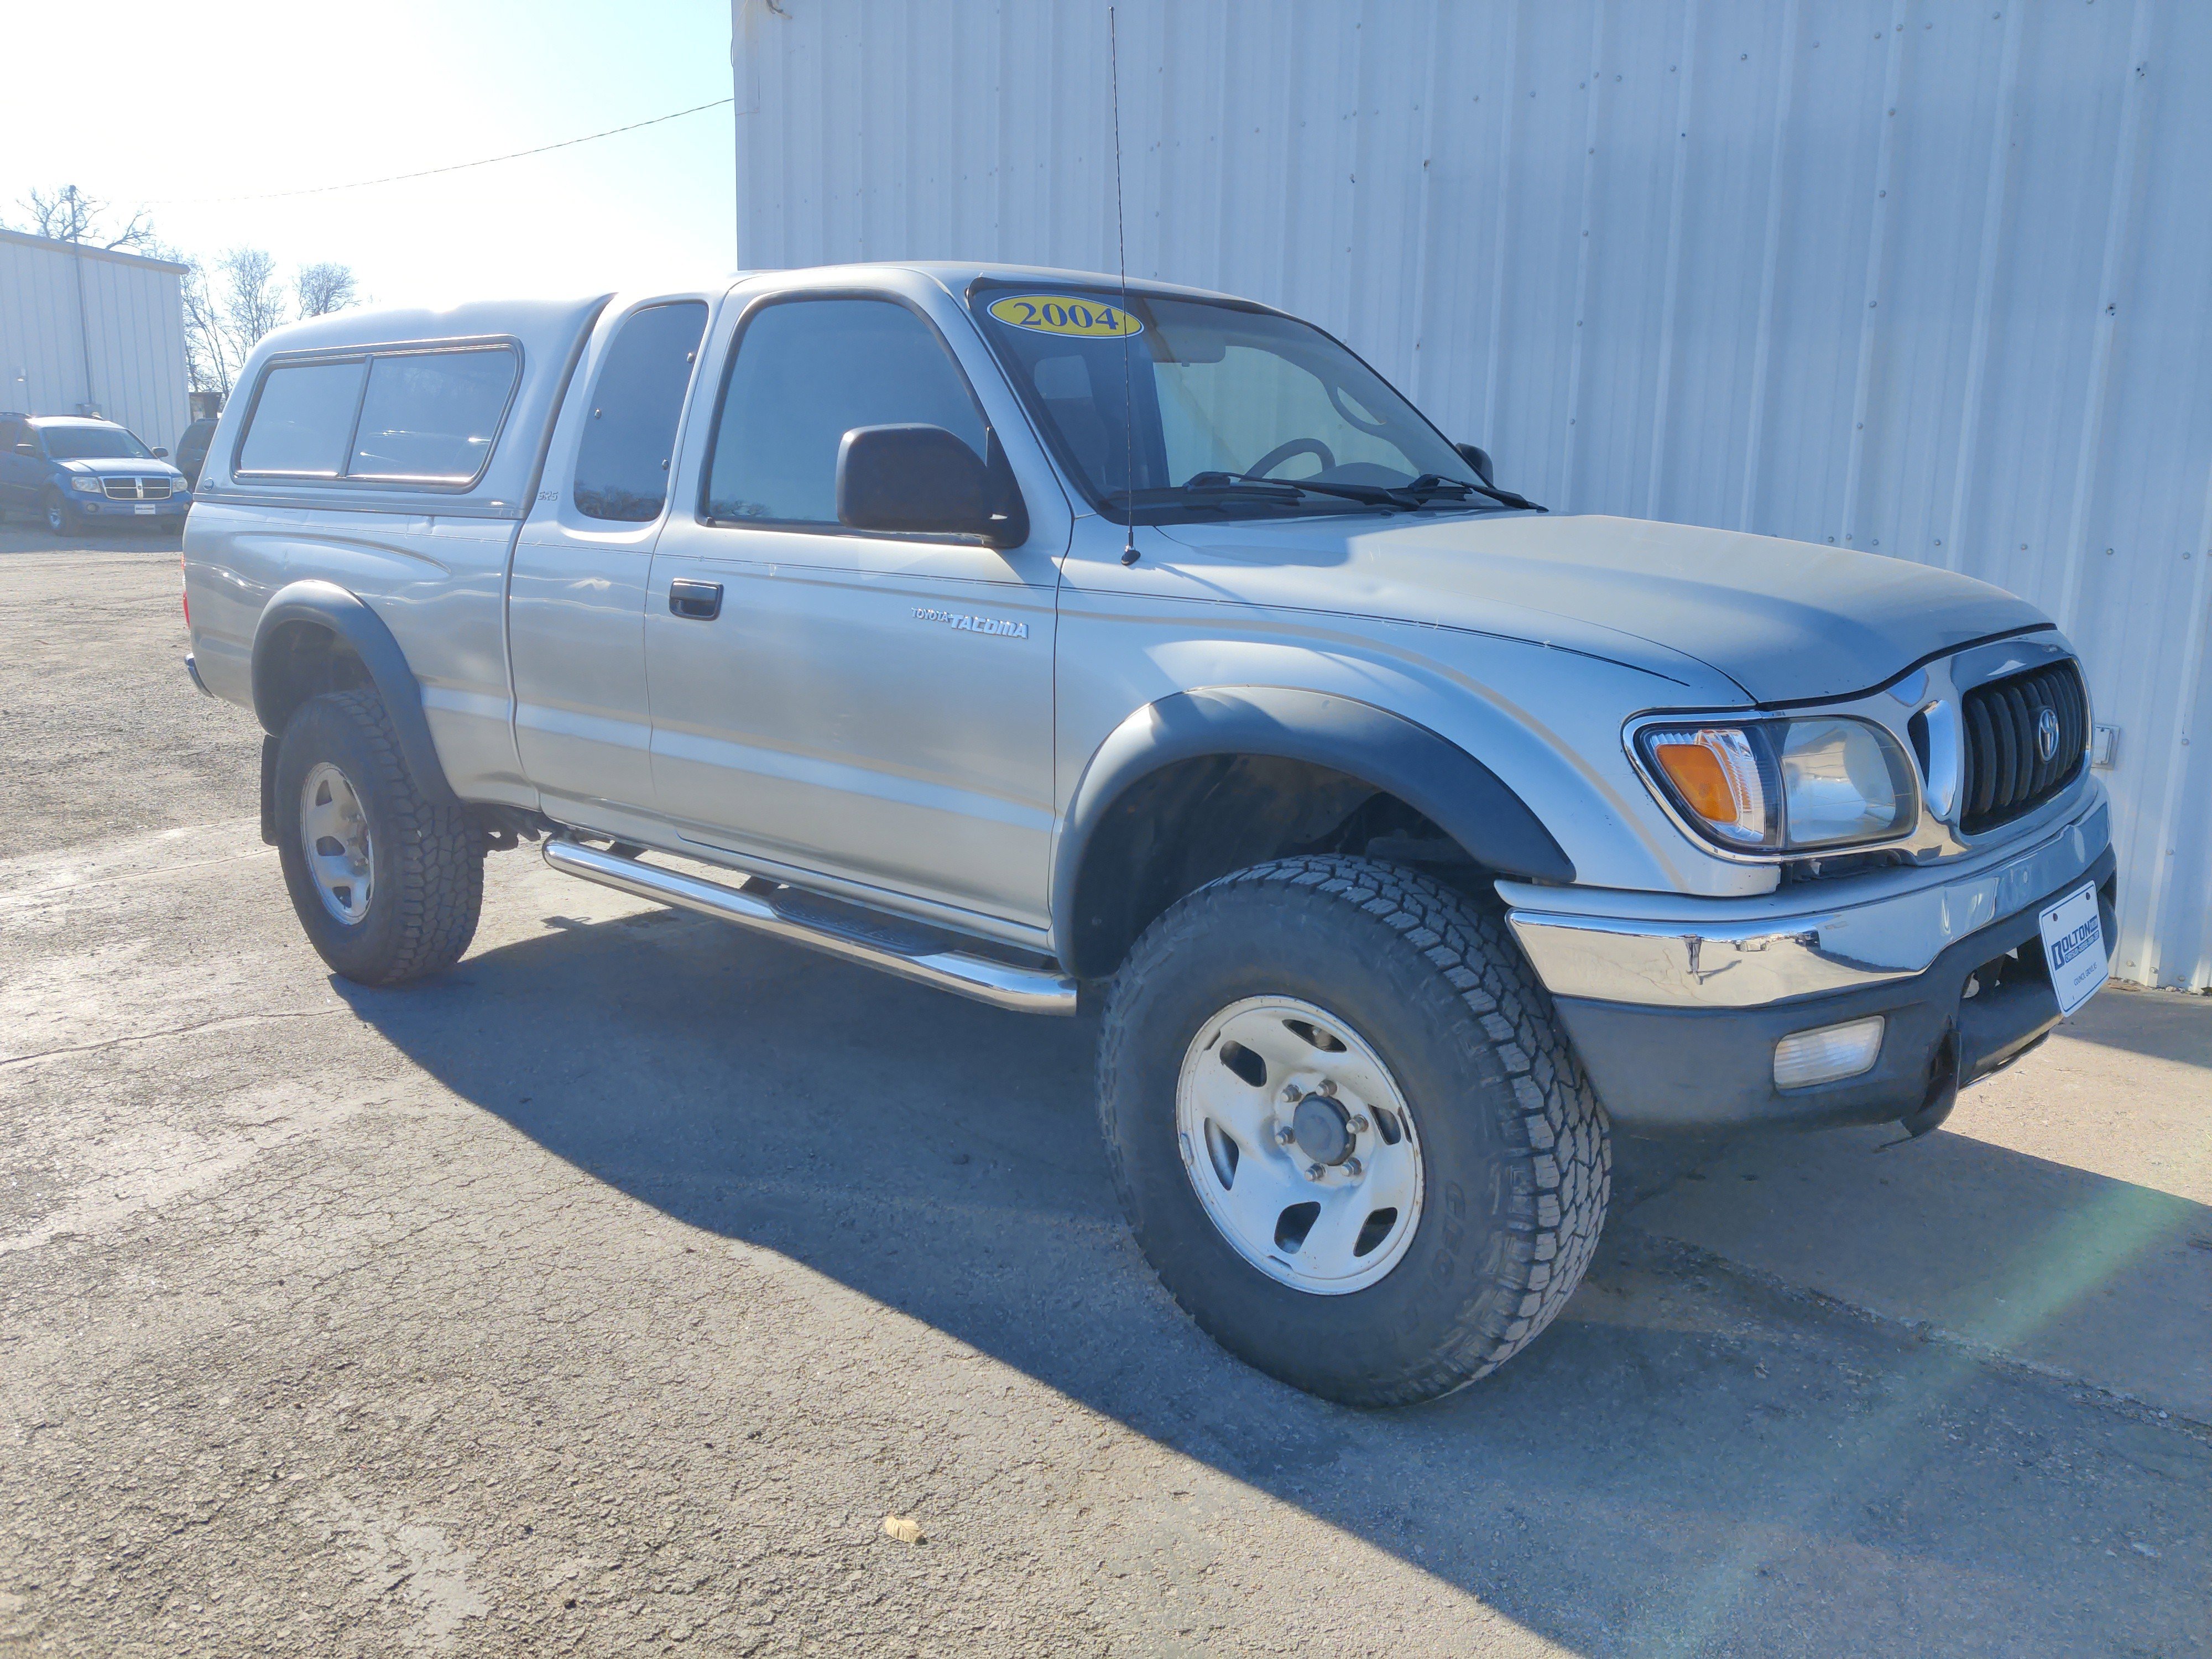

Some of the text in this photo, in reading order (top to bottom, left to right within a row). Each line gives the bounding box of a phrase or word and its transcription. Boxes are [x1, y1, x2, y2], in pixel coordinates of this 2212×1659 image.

[1013, 302, 1119, 330] 2004
[911, 607, 1029, 639] TOYOTA TACOMA
[2051, 920, 2090, 971] BOLTON
